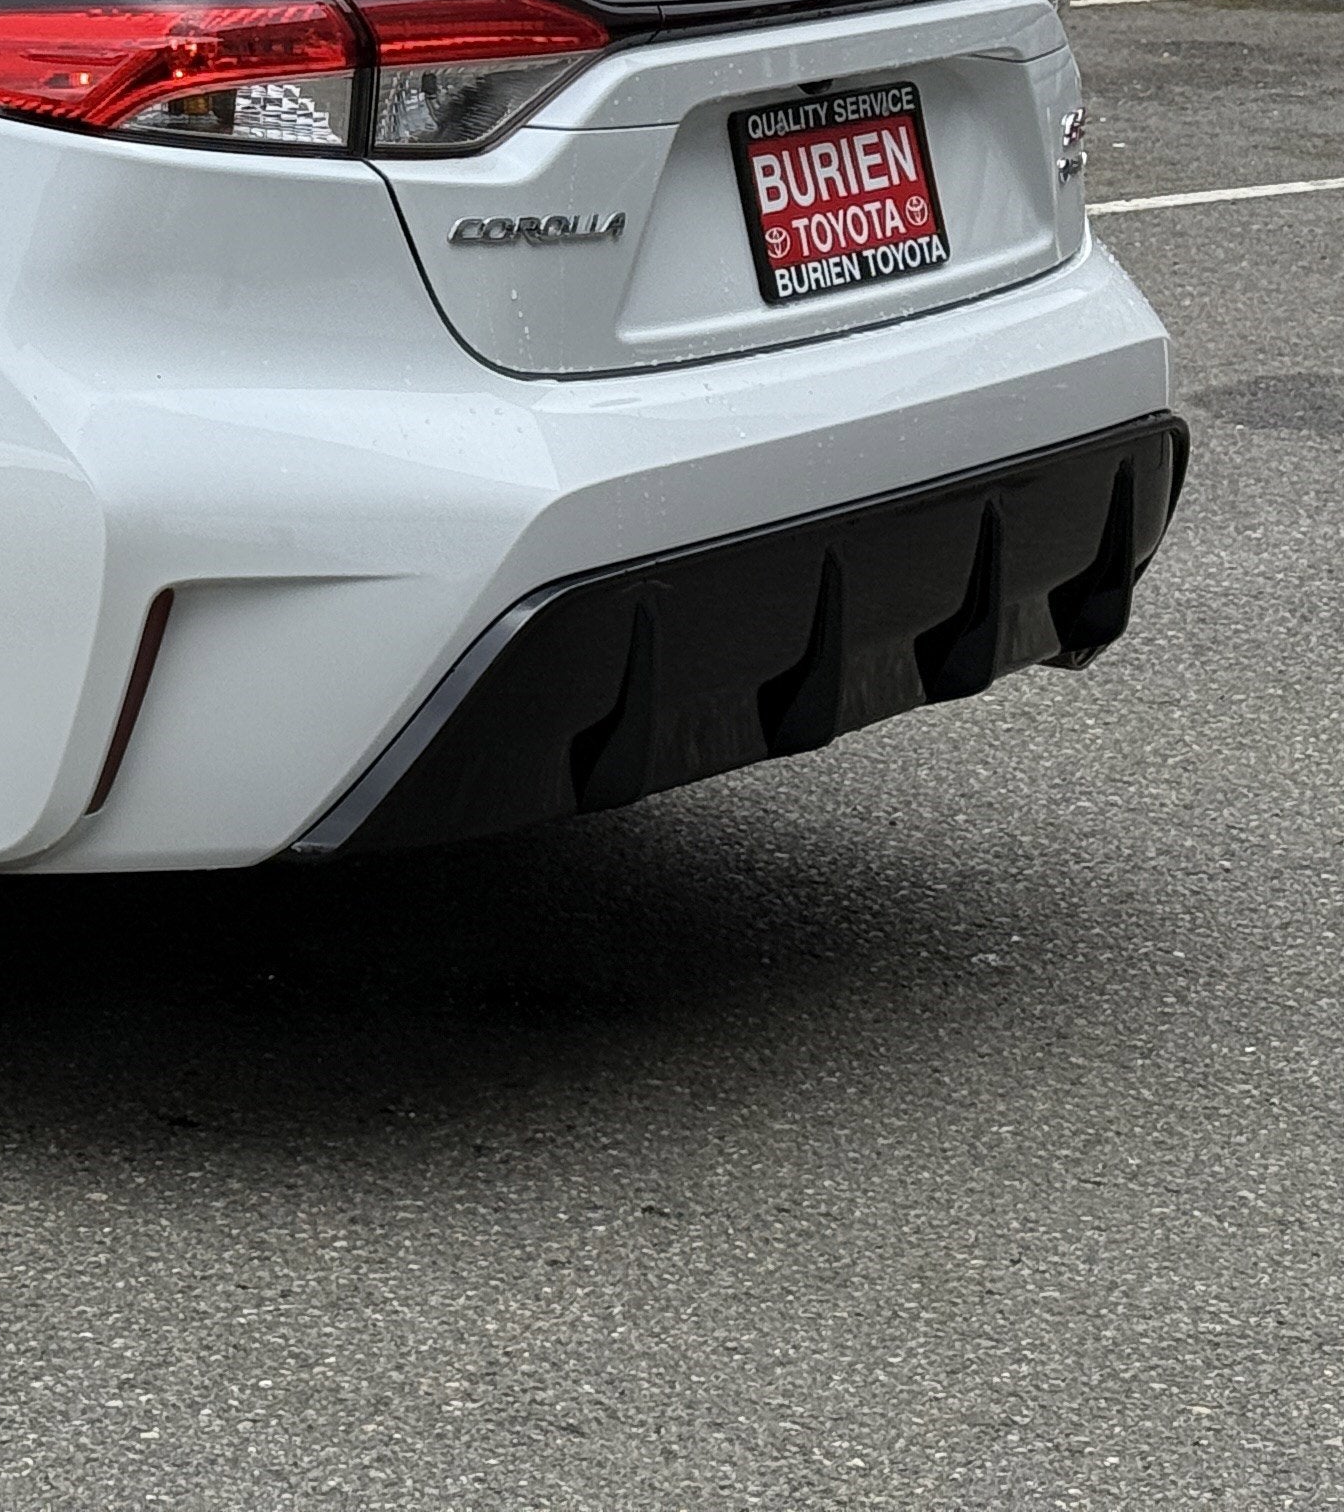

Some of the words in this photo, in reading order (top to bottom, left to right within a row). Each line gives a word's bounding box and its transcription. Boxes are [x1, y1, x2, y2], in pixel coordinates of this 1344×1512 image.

[747, 101, 829, 139] QUALITY
[833, 86, 916, 124] SERVICE
[752, 125, 918, 215] BURIEN
[447, 212, 626, 245] COROLLA
[791, 198, 907, 257] TOYOTA
[774, 254, 862, 298] BURIEN
[863, 234, 948, 278] TOYOTA
